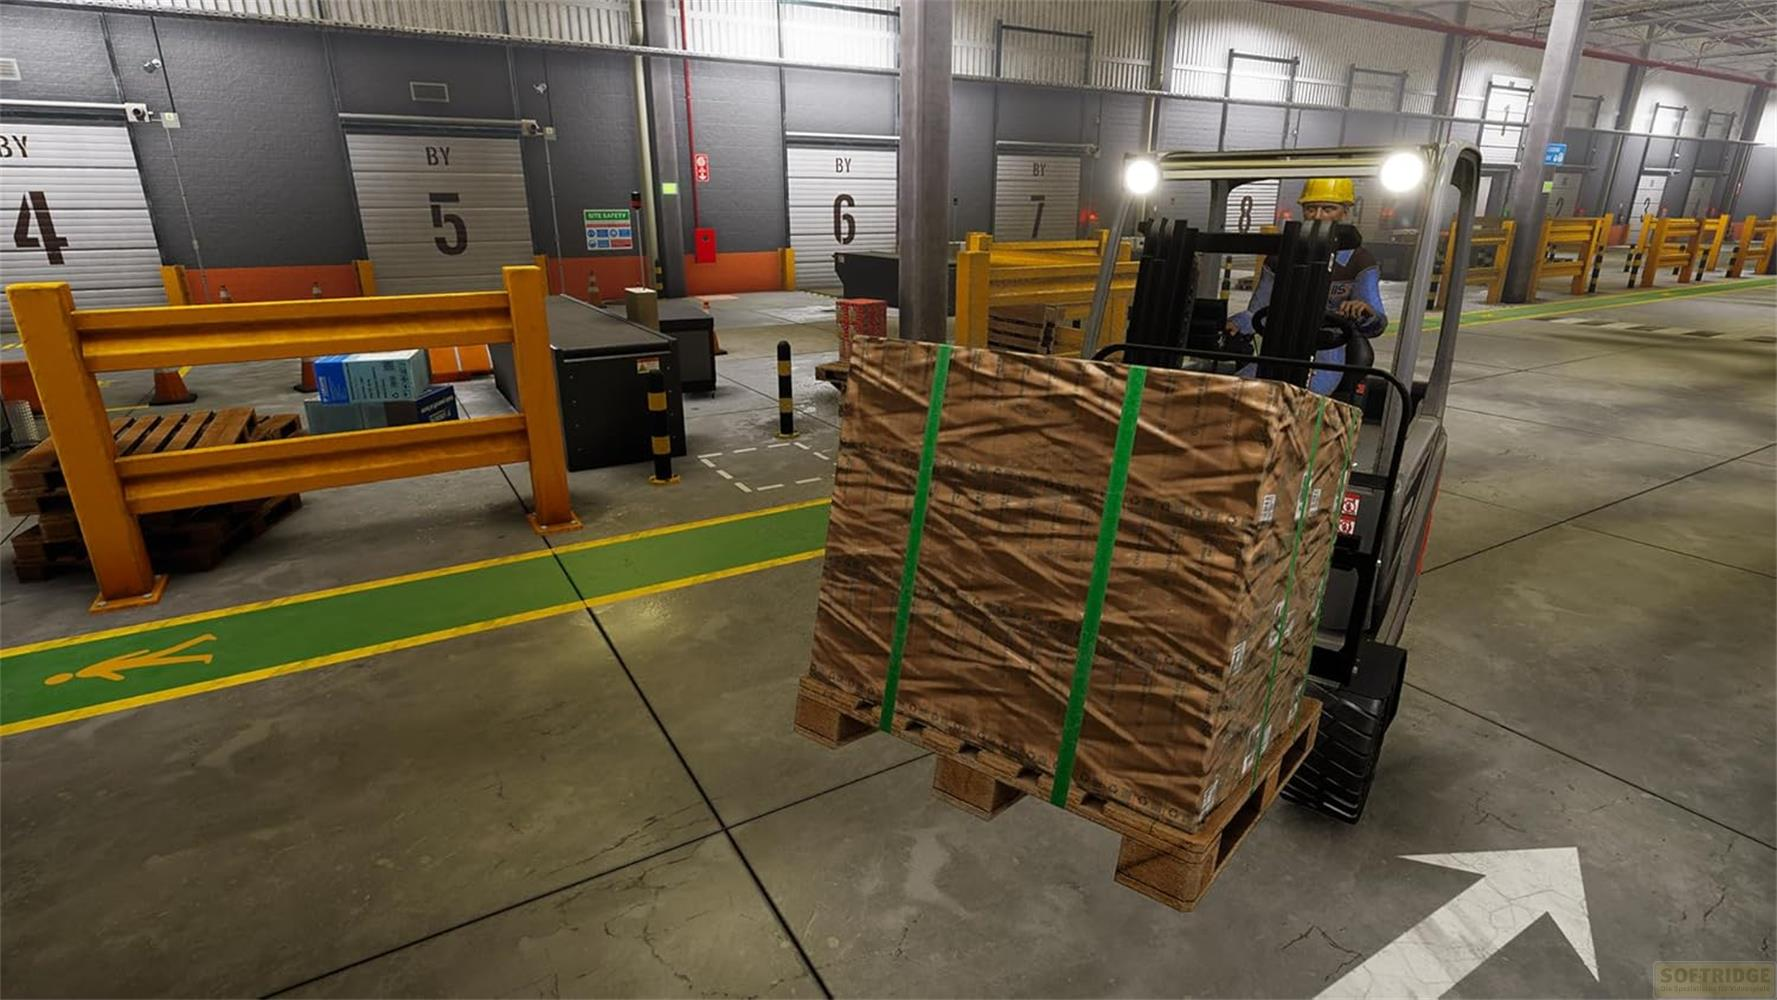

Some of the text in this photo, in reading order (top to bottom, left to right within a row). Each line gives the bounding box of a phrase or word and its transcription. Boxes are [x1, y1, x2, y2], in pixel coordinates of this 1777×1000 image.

[0, 135, 28, 158] BY
[426, 147, 450, 166] BY
[835, 157, 852, 173] BY
[1033, 162, 1047, 176] BY
[13, 191, 70, 265] 4
[429, 192, 468, 256] 5
[833, 193, 856, 245] 6
[1030, 195, 1046, 239] 7
[1238, 195, 1253, 234] 8
